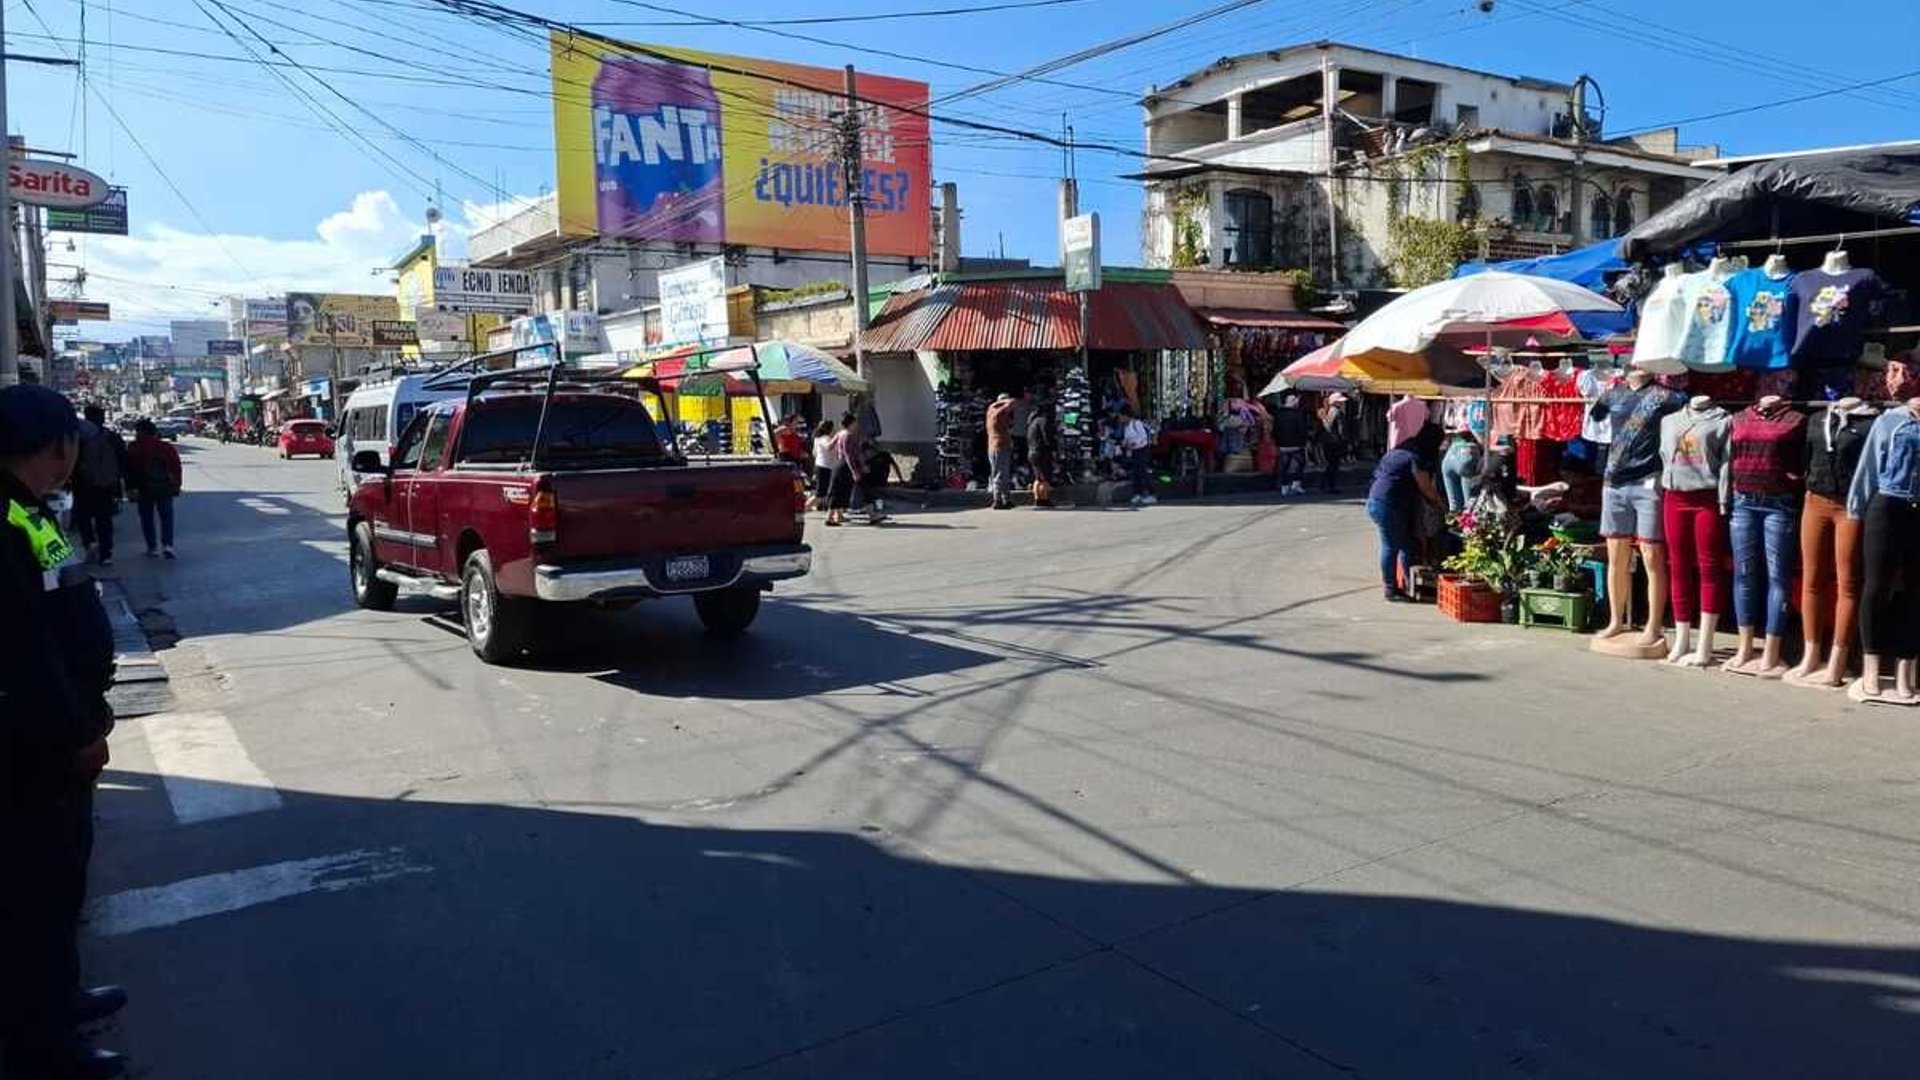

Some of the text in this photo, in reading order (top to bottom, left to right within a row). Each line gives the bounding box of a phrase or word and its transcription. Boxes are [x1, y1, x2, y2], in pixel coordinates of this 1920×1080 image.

[594, 105, 720, 167] FANTA
[10, 165, 91, 198] Sarita
[755, 158, 911, 213] ¿QUIEES?
